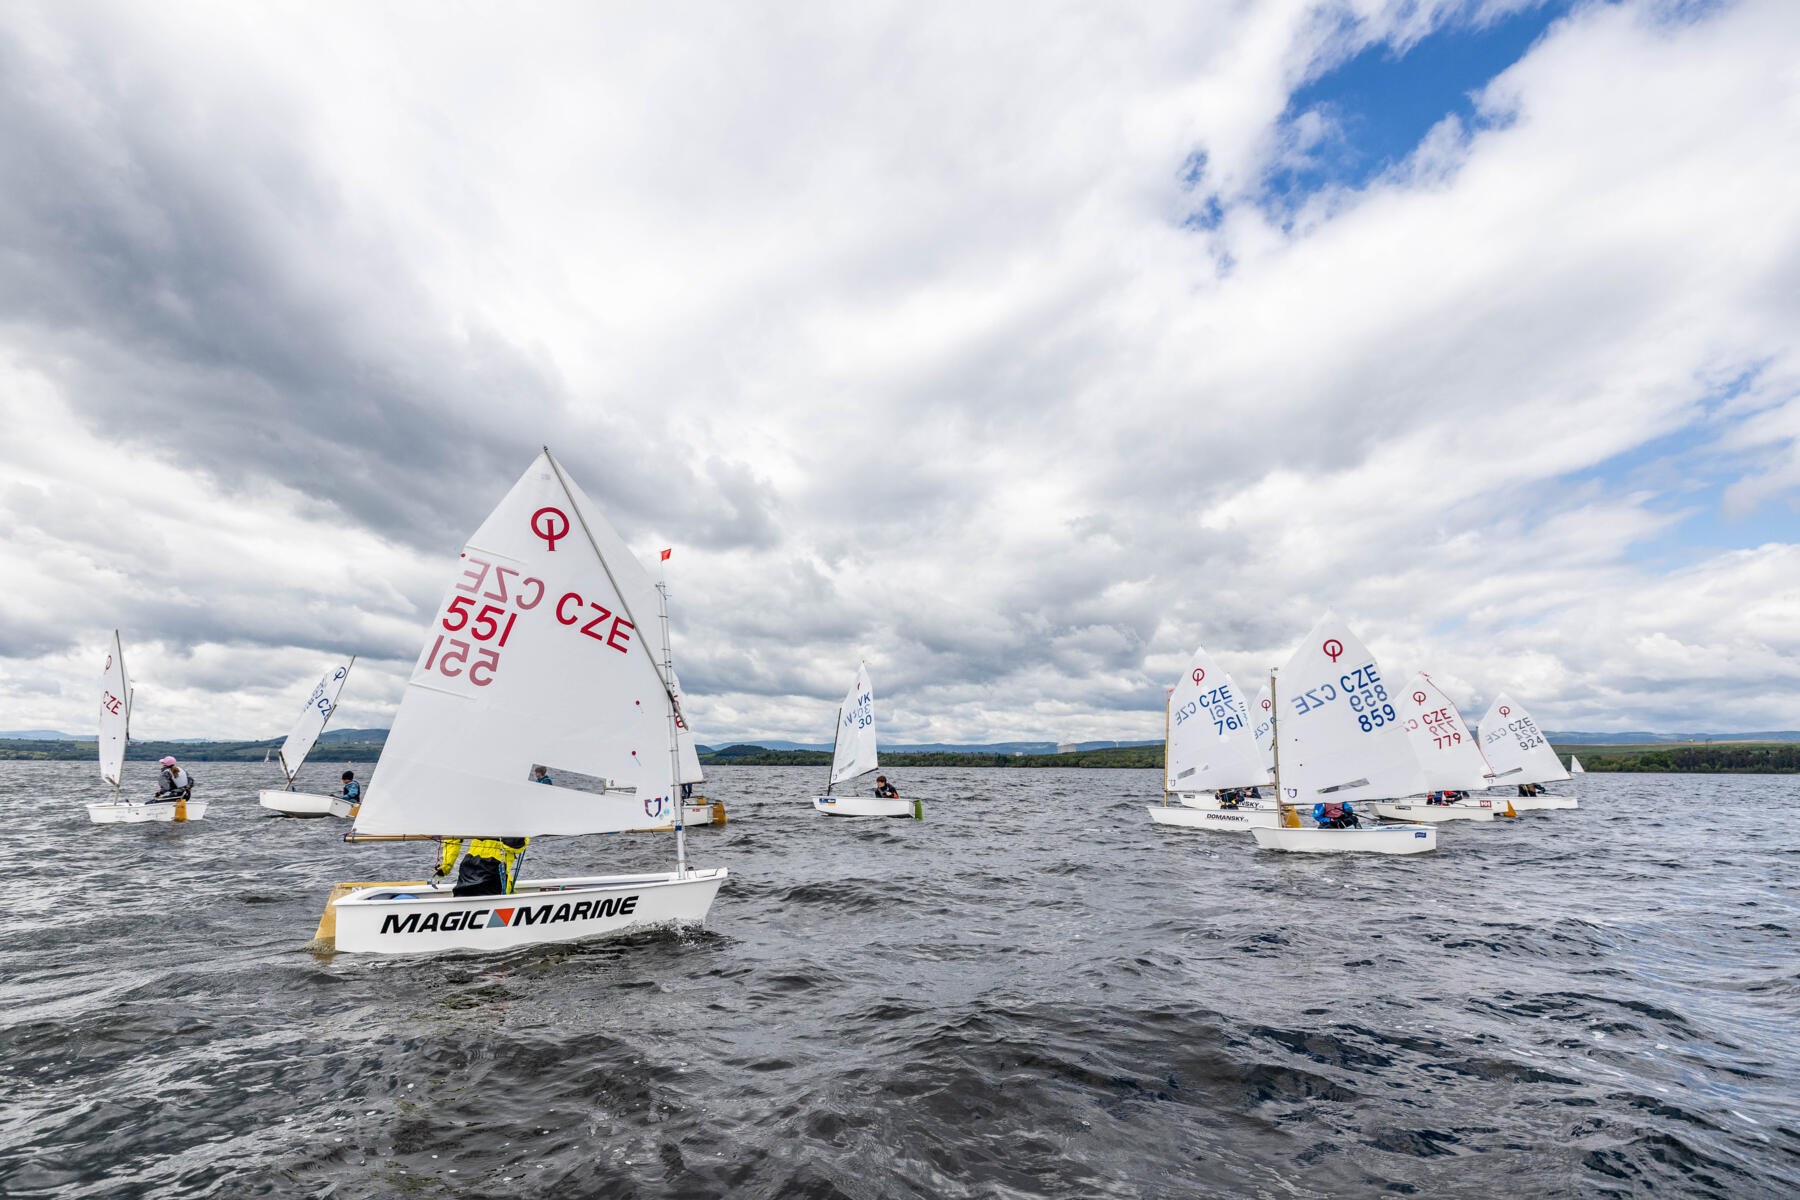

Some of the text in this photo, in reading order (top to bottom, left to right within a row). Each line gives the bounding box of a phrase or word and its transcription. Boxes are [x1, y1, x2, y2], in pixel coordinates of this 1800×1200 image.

[442, 595, 518, 647] 551
[556, 592, 635, 654] CZE
[1340, 664, 1380, 693] CZE
[103, 690, 123, 715] CZE
[1199, 685, 1232, 707] CZE
[858, 714, 872, 729] 30
[1214, 714, 1243, 735] 761
[1358, 704, 1396, 732] 859
[1422, 707, 1453, 725] CZE
[1508, 717, 1533, 732] CZE
[1433, 732, 1461, 750] 779
[1519, 735, 1544, 751] 924
[380, 895, 639, 934] MAGIC MARINE
